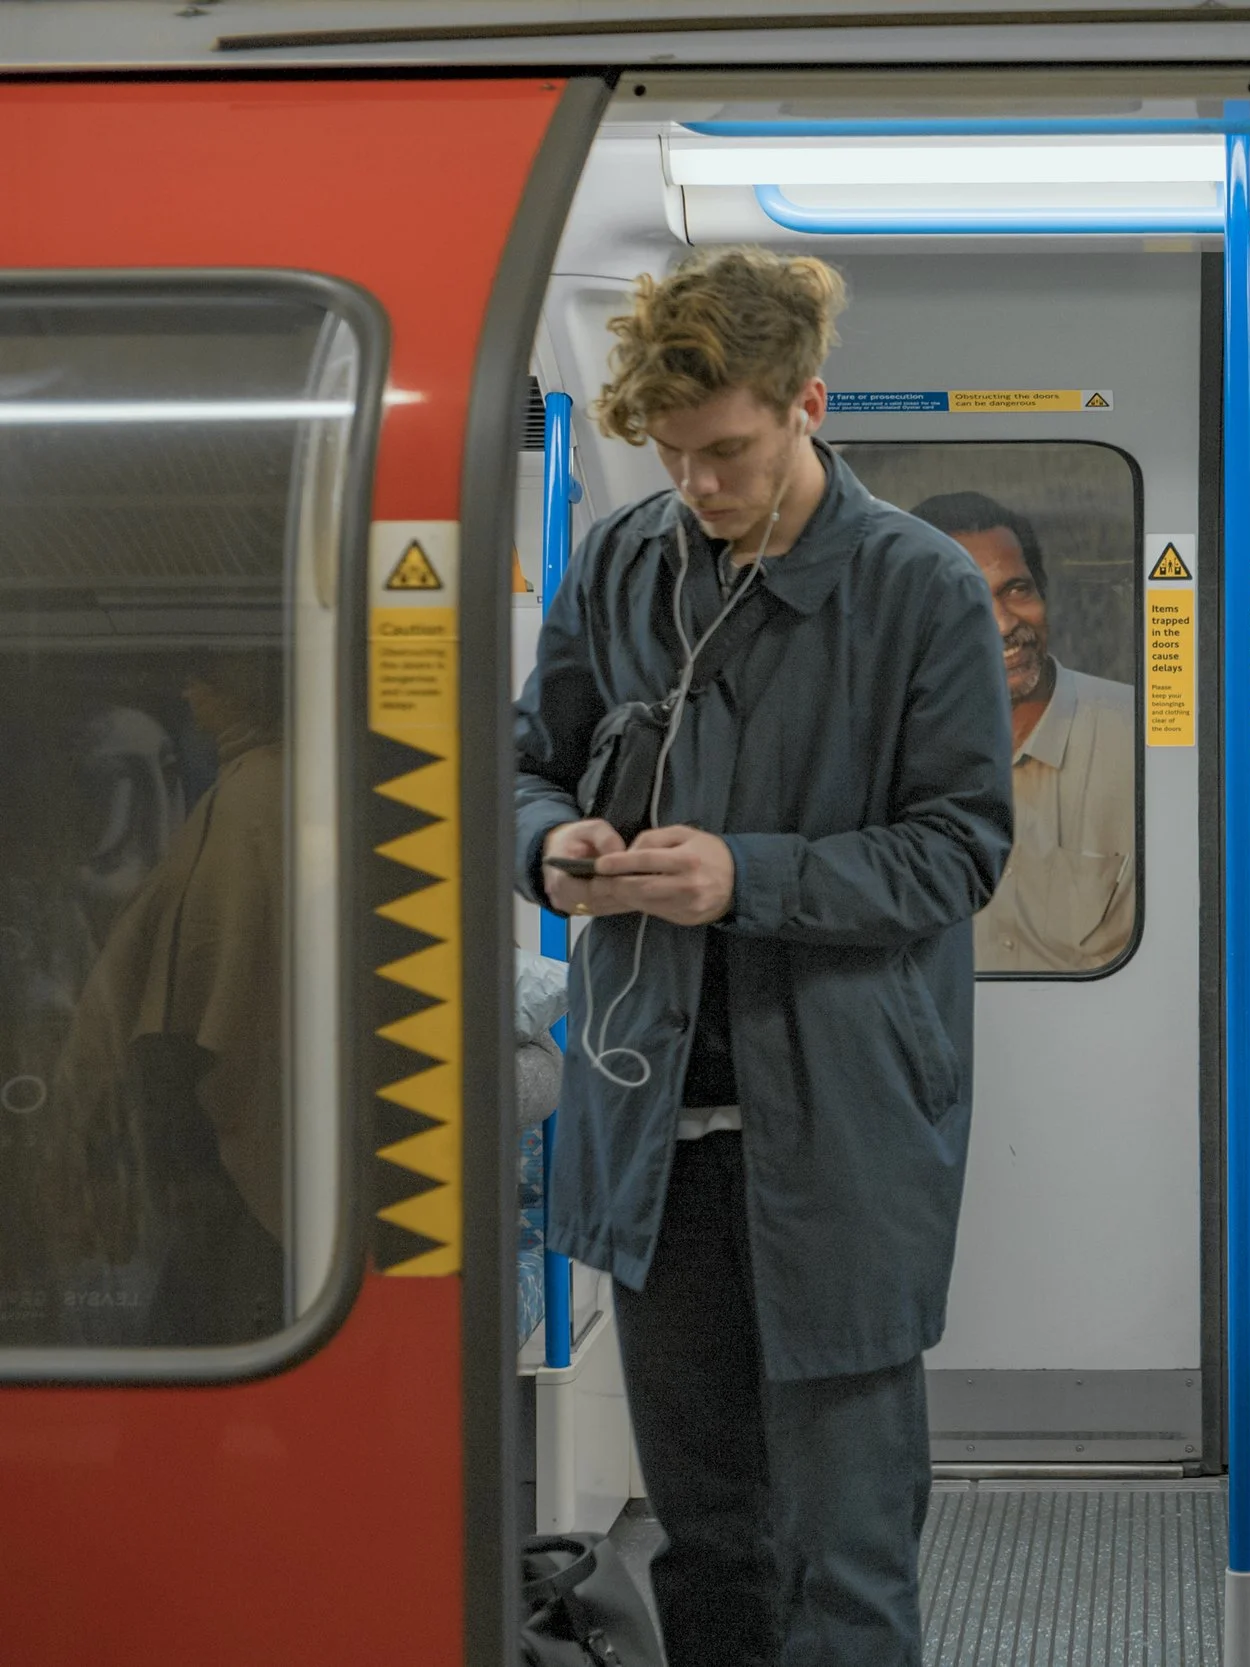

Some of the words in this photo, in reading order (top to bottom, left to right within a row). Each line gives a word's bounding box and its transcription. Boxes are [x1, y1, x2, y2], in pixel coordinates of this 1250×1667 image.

[1152, 605, 1179, 613] Items
[1152, 617, 1190, 627] trapped
[1164, 628, 1180, 637] the
[1152, 640, 1179, 648] doors
[1152, 664, 1182, 674] delays
